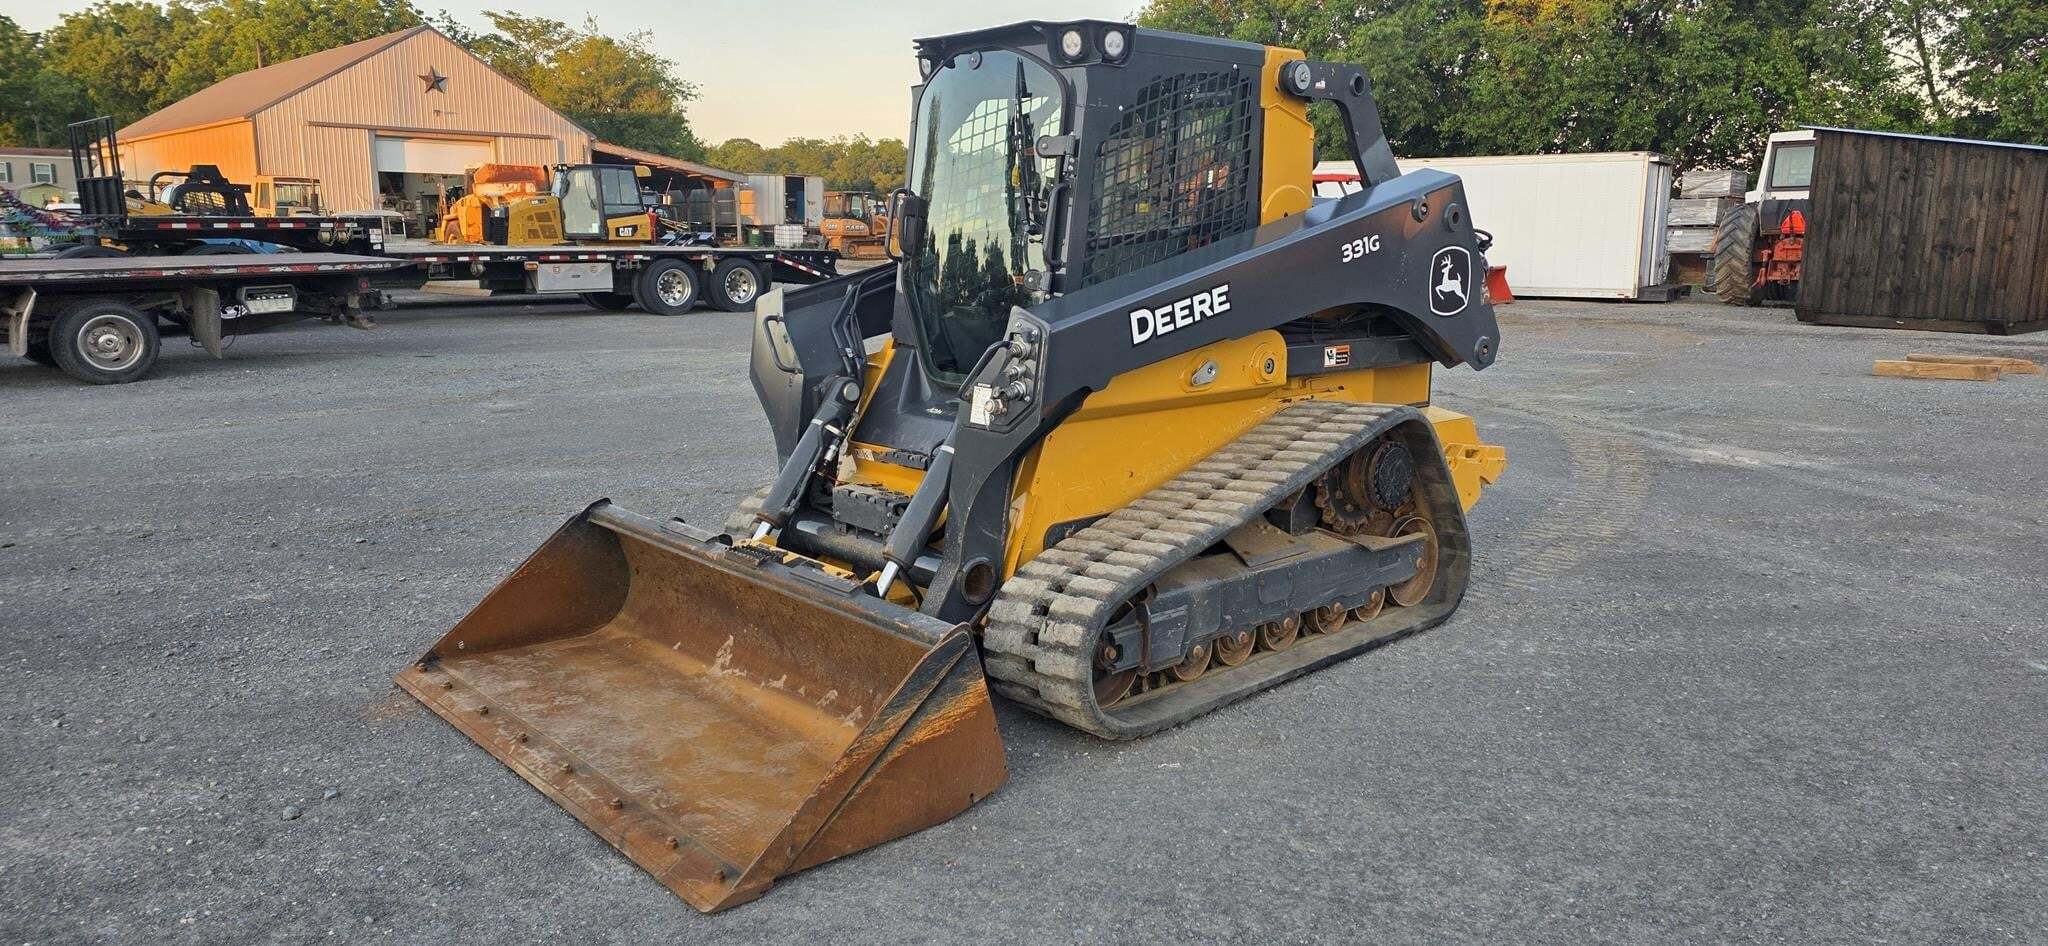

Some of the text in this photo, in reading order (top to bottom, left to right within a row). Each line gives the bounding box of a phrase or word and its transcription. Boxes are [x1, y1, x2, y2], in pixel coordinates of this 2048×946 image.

[619, 227, 633, 237] CAT
[1341, 234, 1380, 263] 331G
[1129, 284, 1231, 345] DEERE
